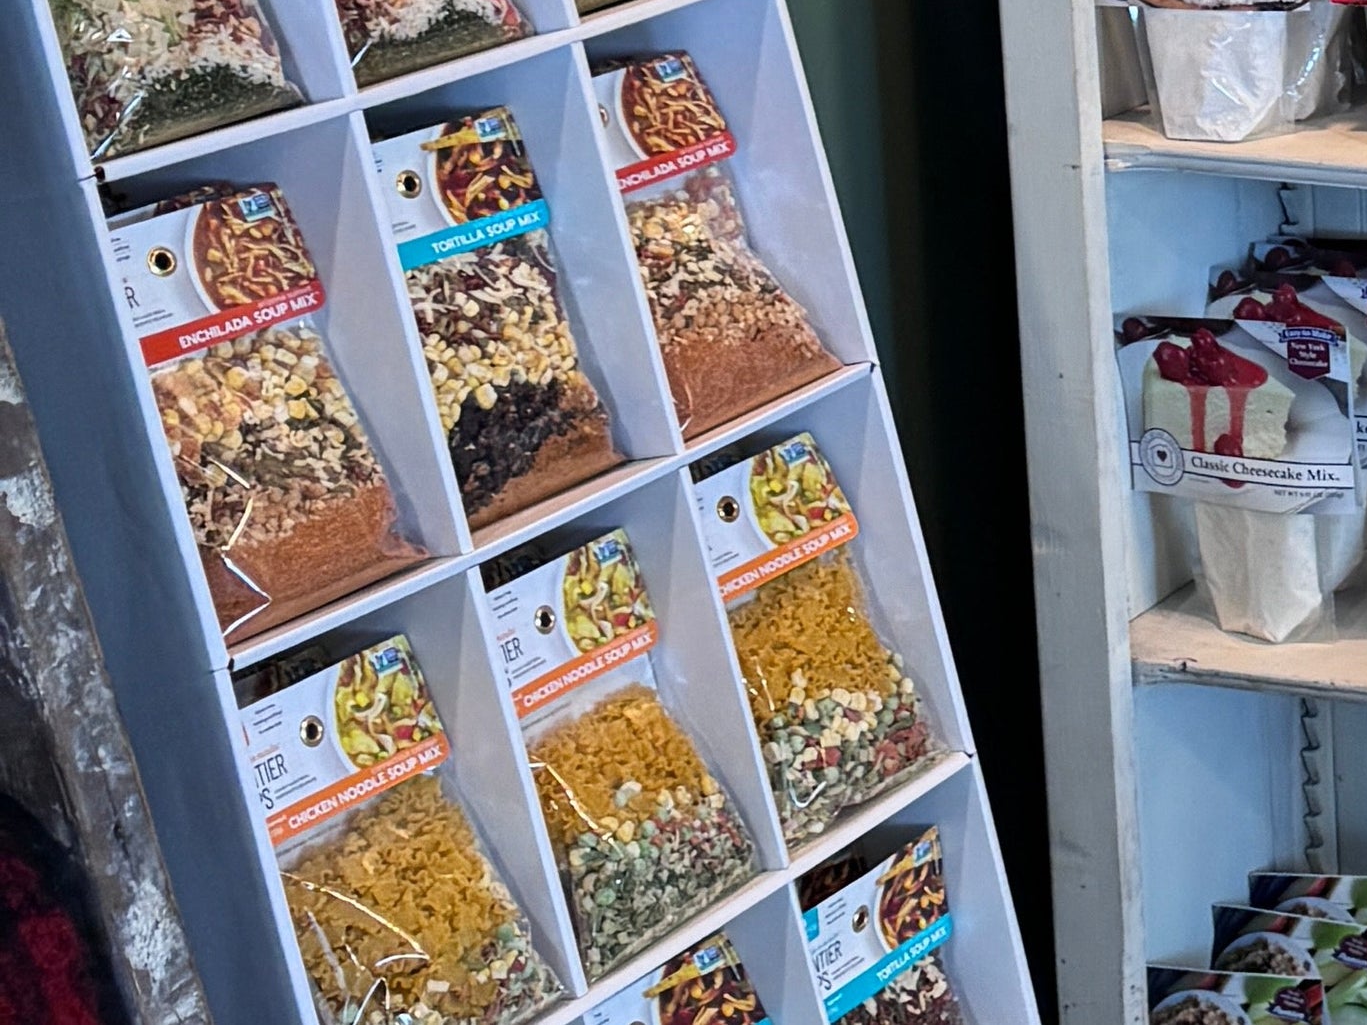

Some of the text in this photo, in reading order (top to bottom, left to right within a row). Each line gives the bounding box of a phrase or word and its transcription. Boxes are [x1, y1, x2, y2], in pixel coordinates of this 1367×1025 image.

[431, 211, 541, 255] TORTILLA SOUP MIX
[179, 292, 319, 351] ENCHILADA SOUP MIX
[1191, 456, 1303, 482] Classic Cheesecake
[288, 744, 444, 830] CHICKEN NOODLE SOUP MIX
